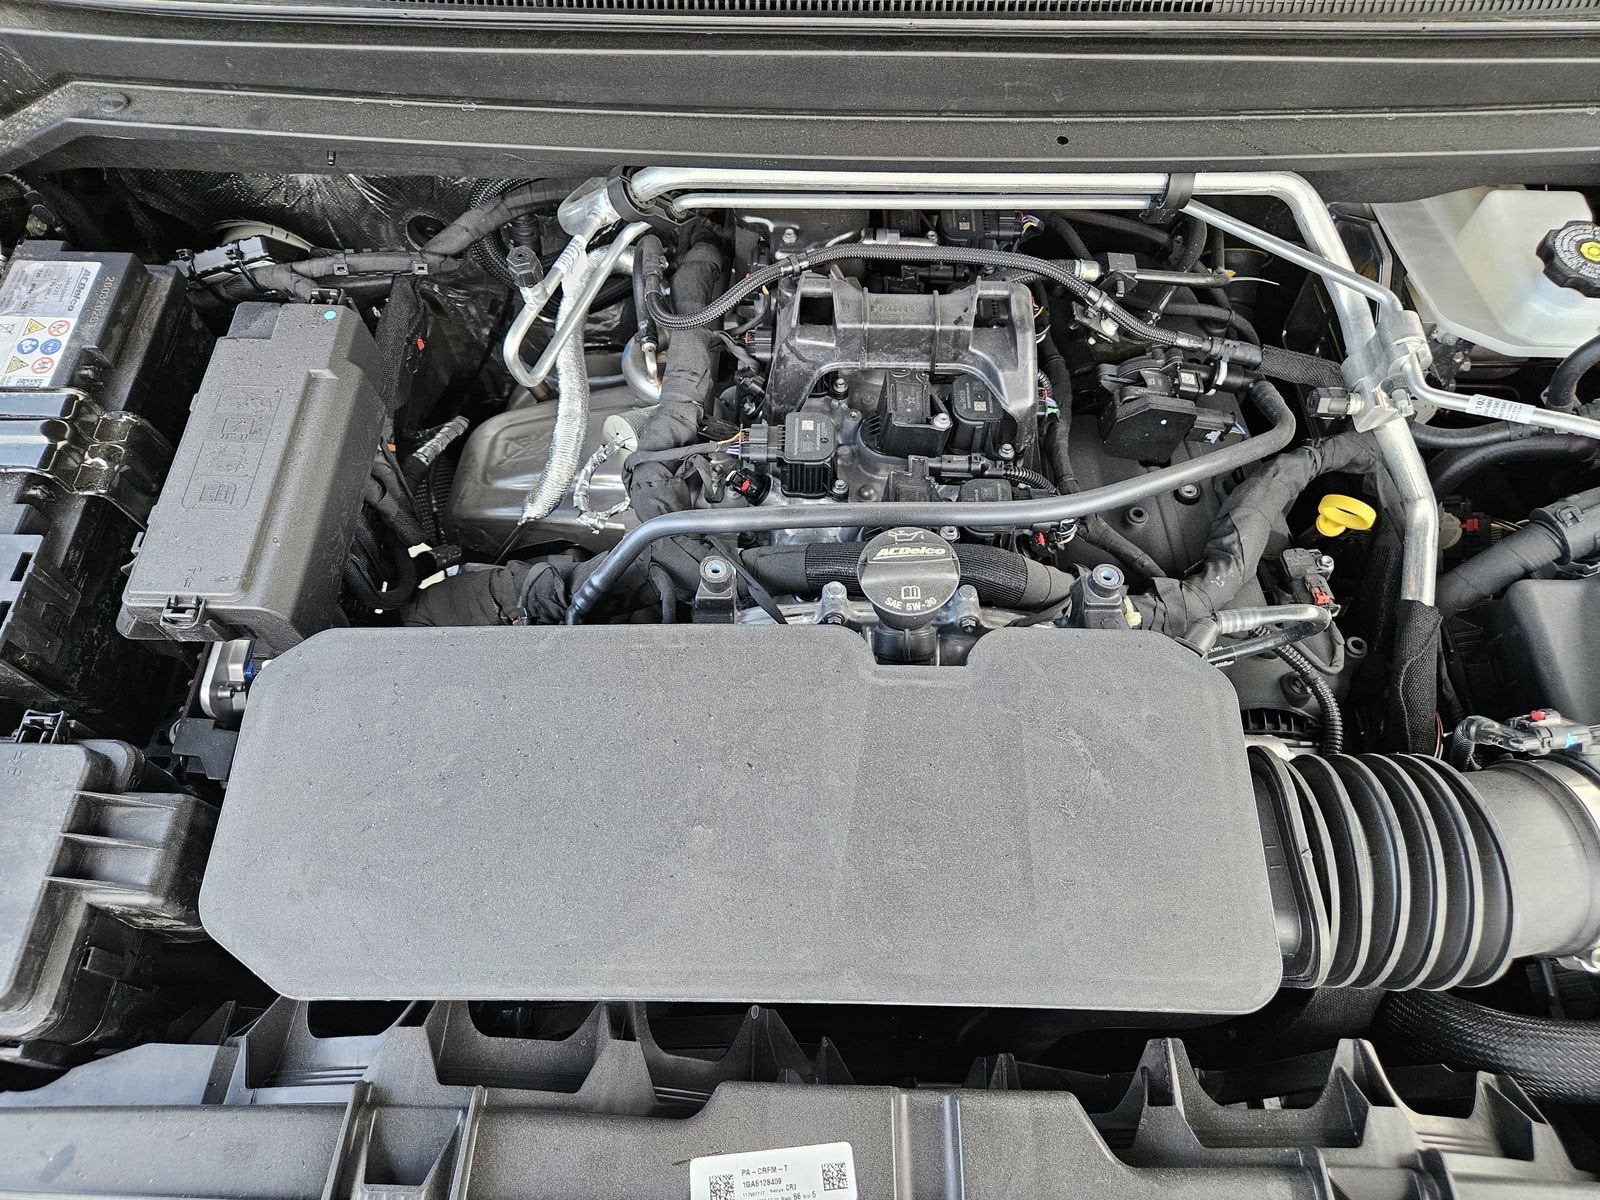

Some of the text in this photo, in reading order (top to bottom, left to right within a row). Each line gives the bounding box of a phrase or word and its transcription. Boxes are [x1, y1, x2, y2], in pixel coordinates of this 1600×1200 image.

[67, 268, 92, 312] ACDelco
[874, 546, 946, 557] ACDelco
[885, 597, 937, 611] SAE 5W-30
